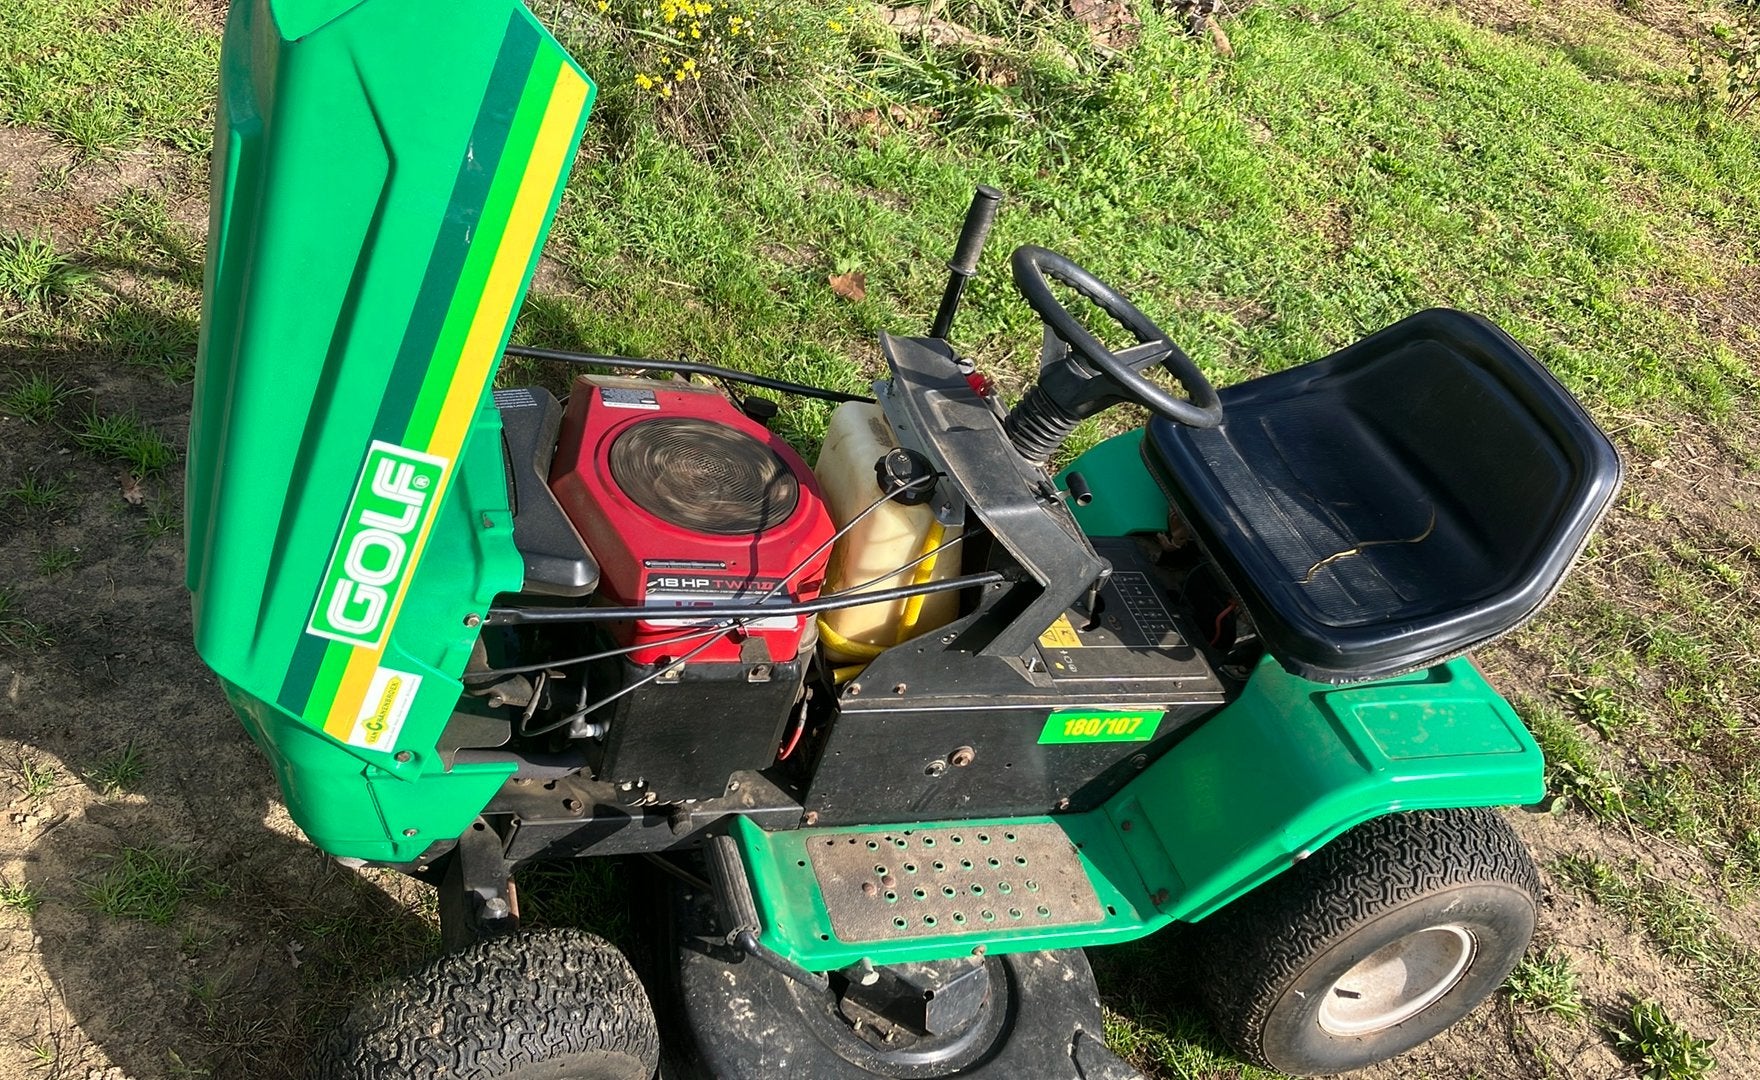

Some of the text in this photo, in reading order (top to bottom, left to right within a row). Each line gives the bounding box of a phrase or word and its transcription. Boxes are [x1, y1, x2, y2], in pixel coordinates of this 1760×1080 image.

[326, 457, 427, 634] GOLF
[657, 578, 679, 587] 18
[681, 578, 710, 588] HP
[1064, 718, 1144, 736] 180/107
